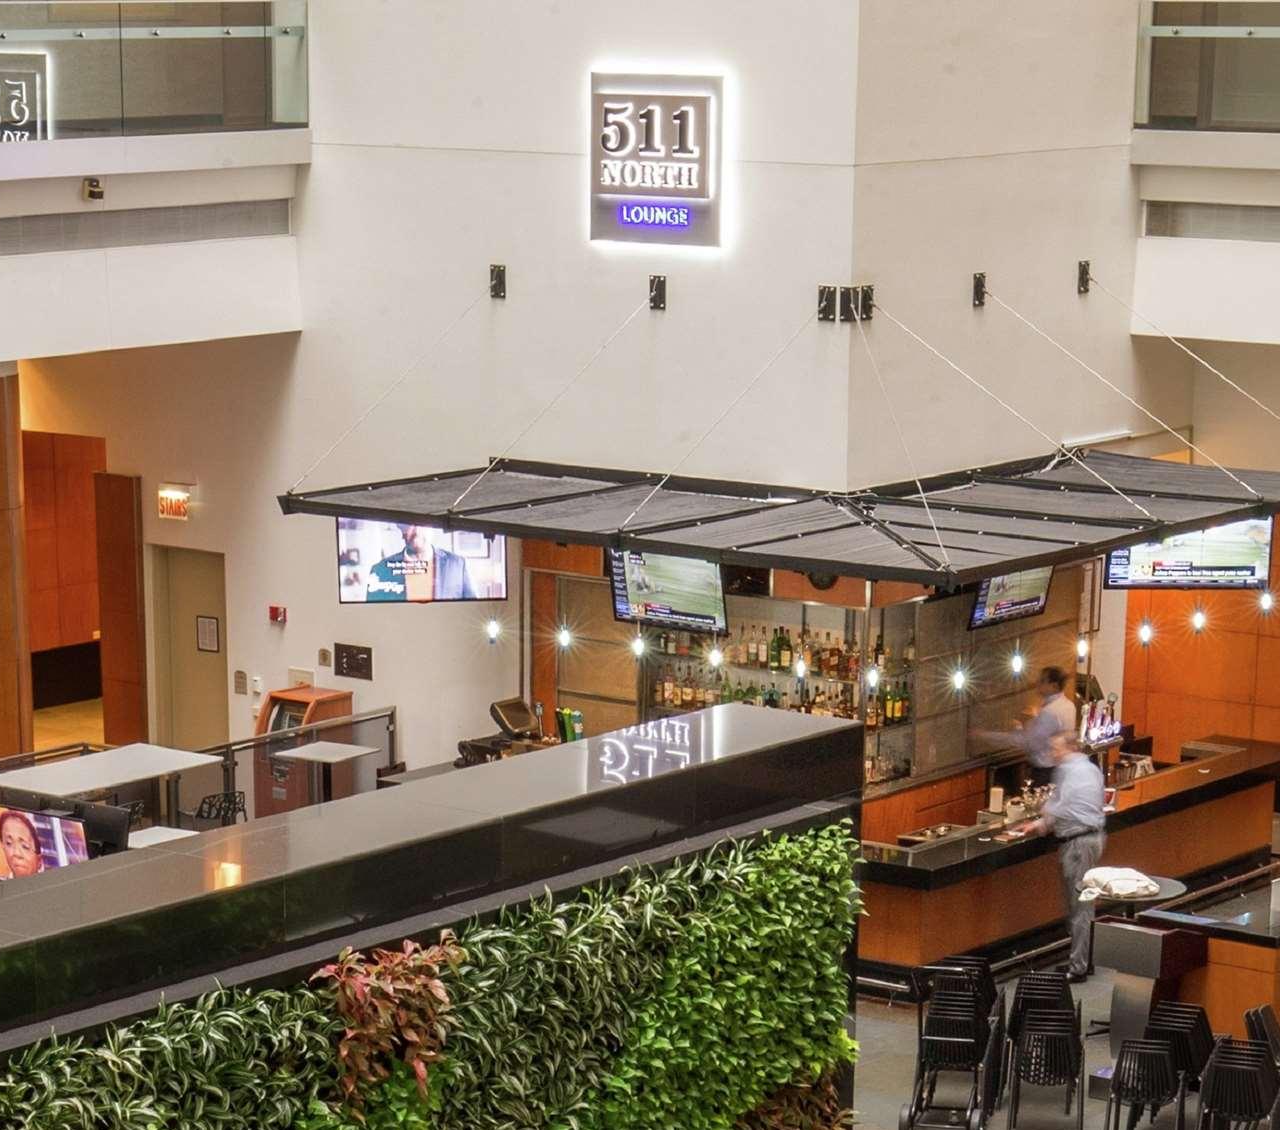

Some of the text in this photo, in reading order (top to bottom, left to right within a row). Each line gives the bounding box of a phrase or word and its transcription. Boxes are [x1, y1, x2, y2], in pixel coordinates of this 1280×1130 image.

[601, 102, 700, 157] 511
[600, 159, 699, 189] NORTH
[622, 205, 689, 226] LOUNGE
